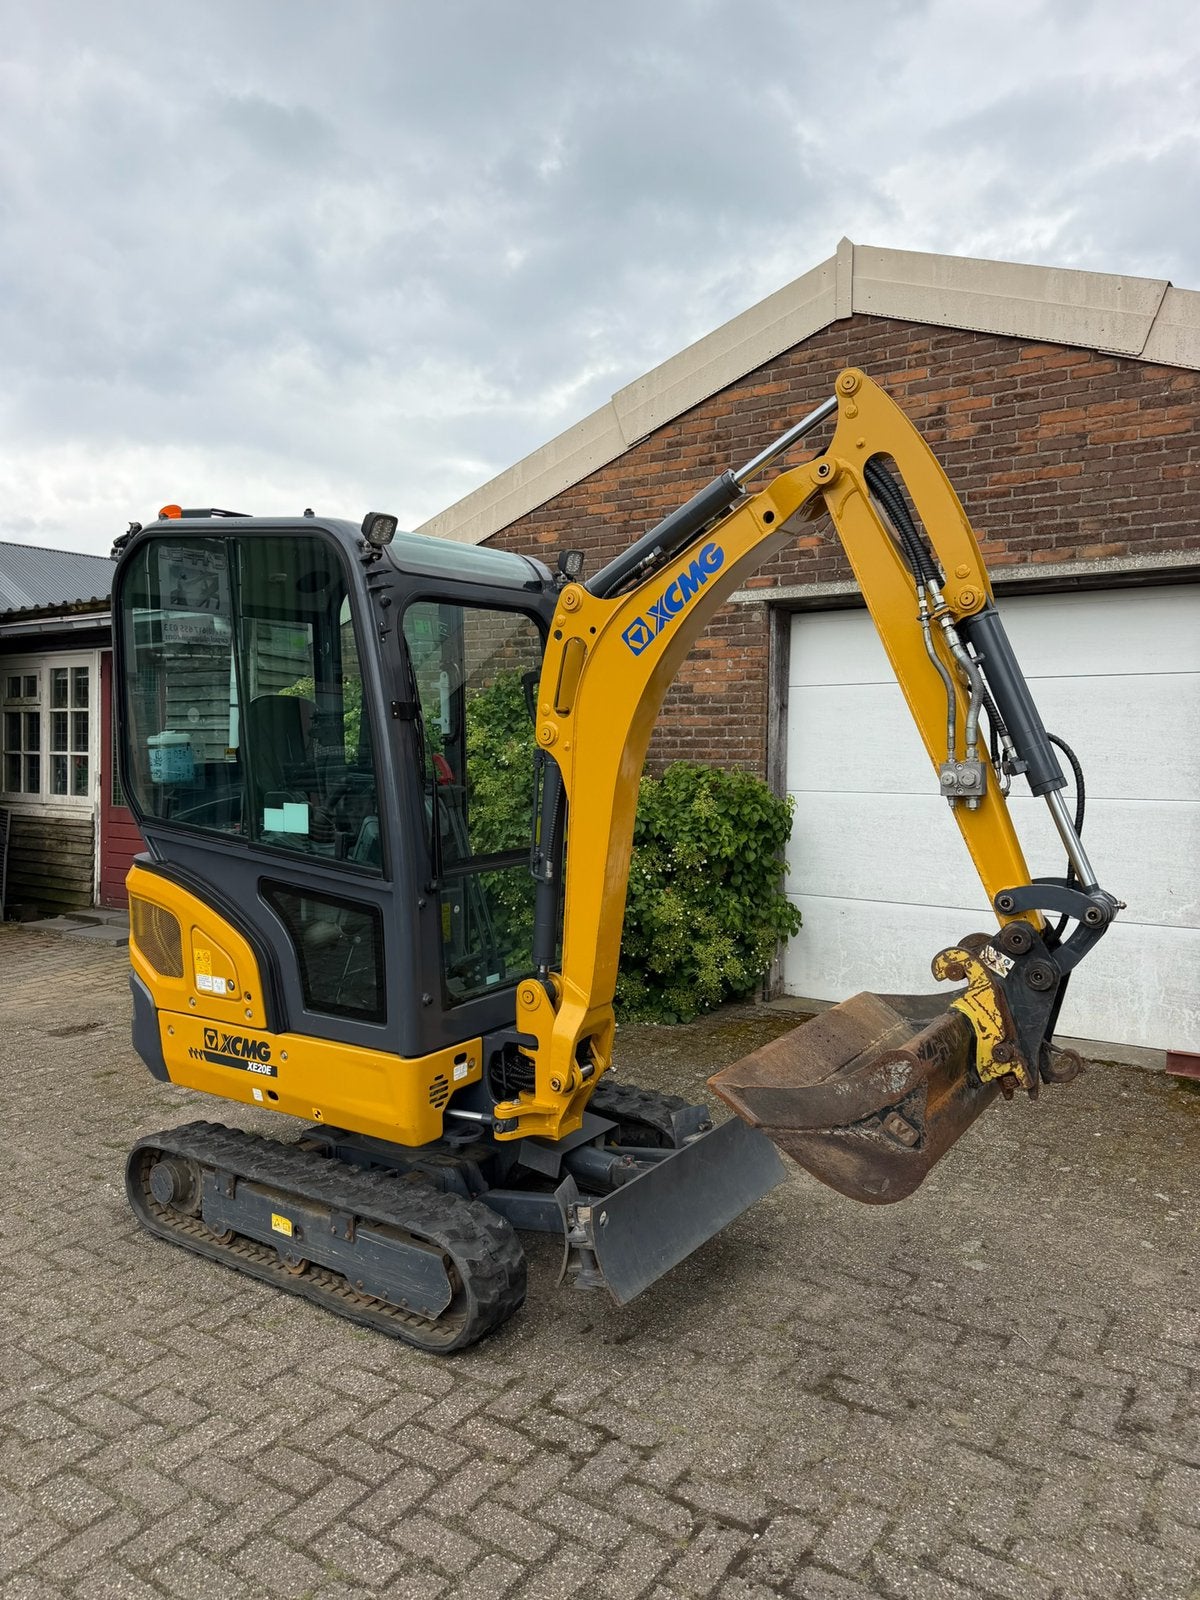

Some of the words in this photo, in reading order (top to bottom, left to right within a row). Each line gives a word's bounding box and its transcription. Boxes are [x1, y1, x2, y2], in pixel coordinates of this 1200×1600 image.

[646, 542, 725, 636] XCMG
[218, 1033, 271, 1062] XCMG
[247, 1061, 272, 1075] XE20E
